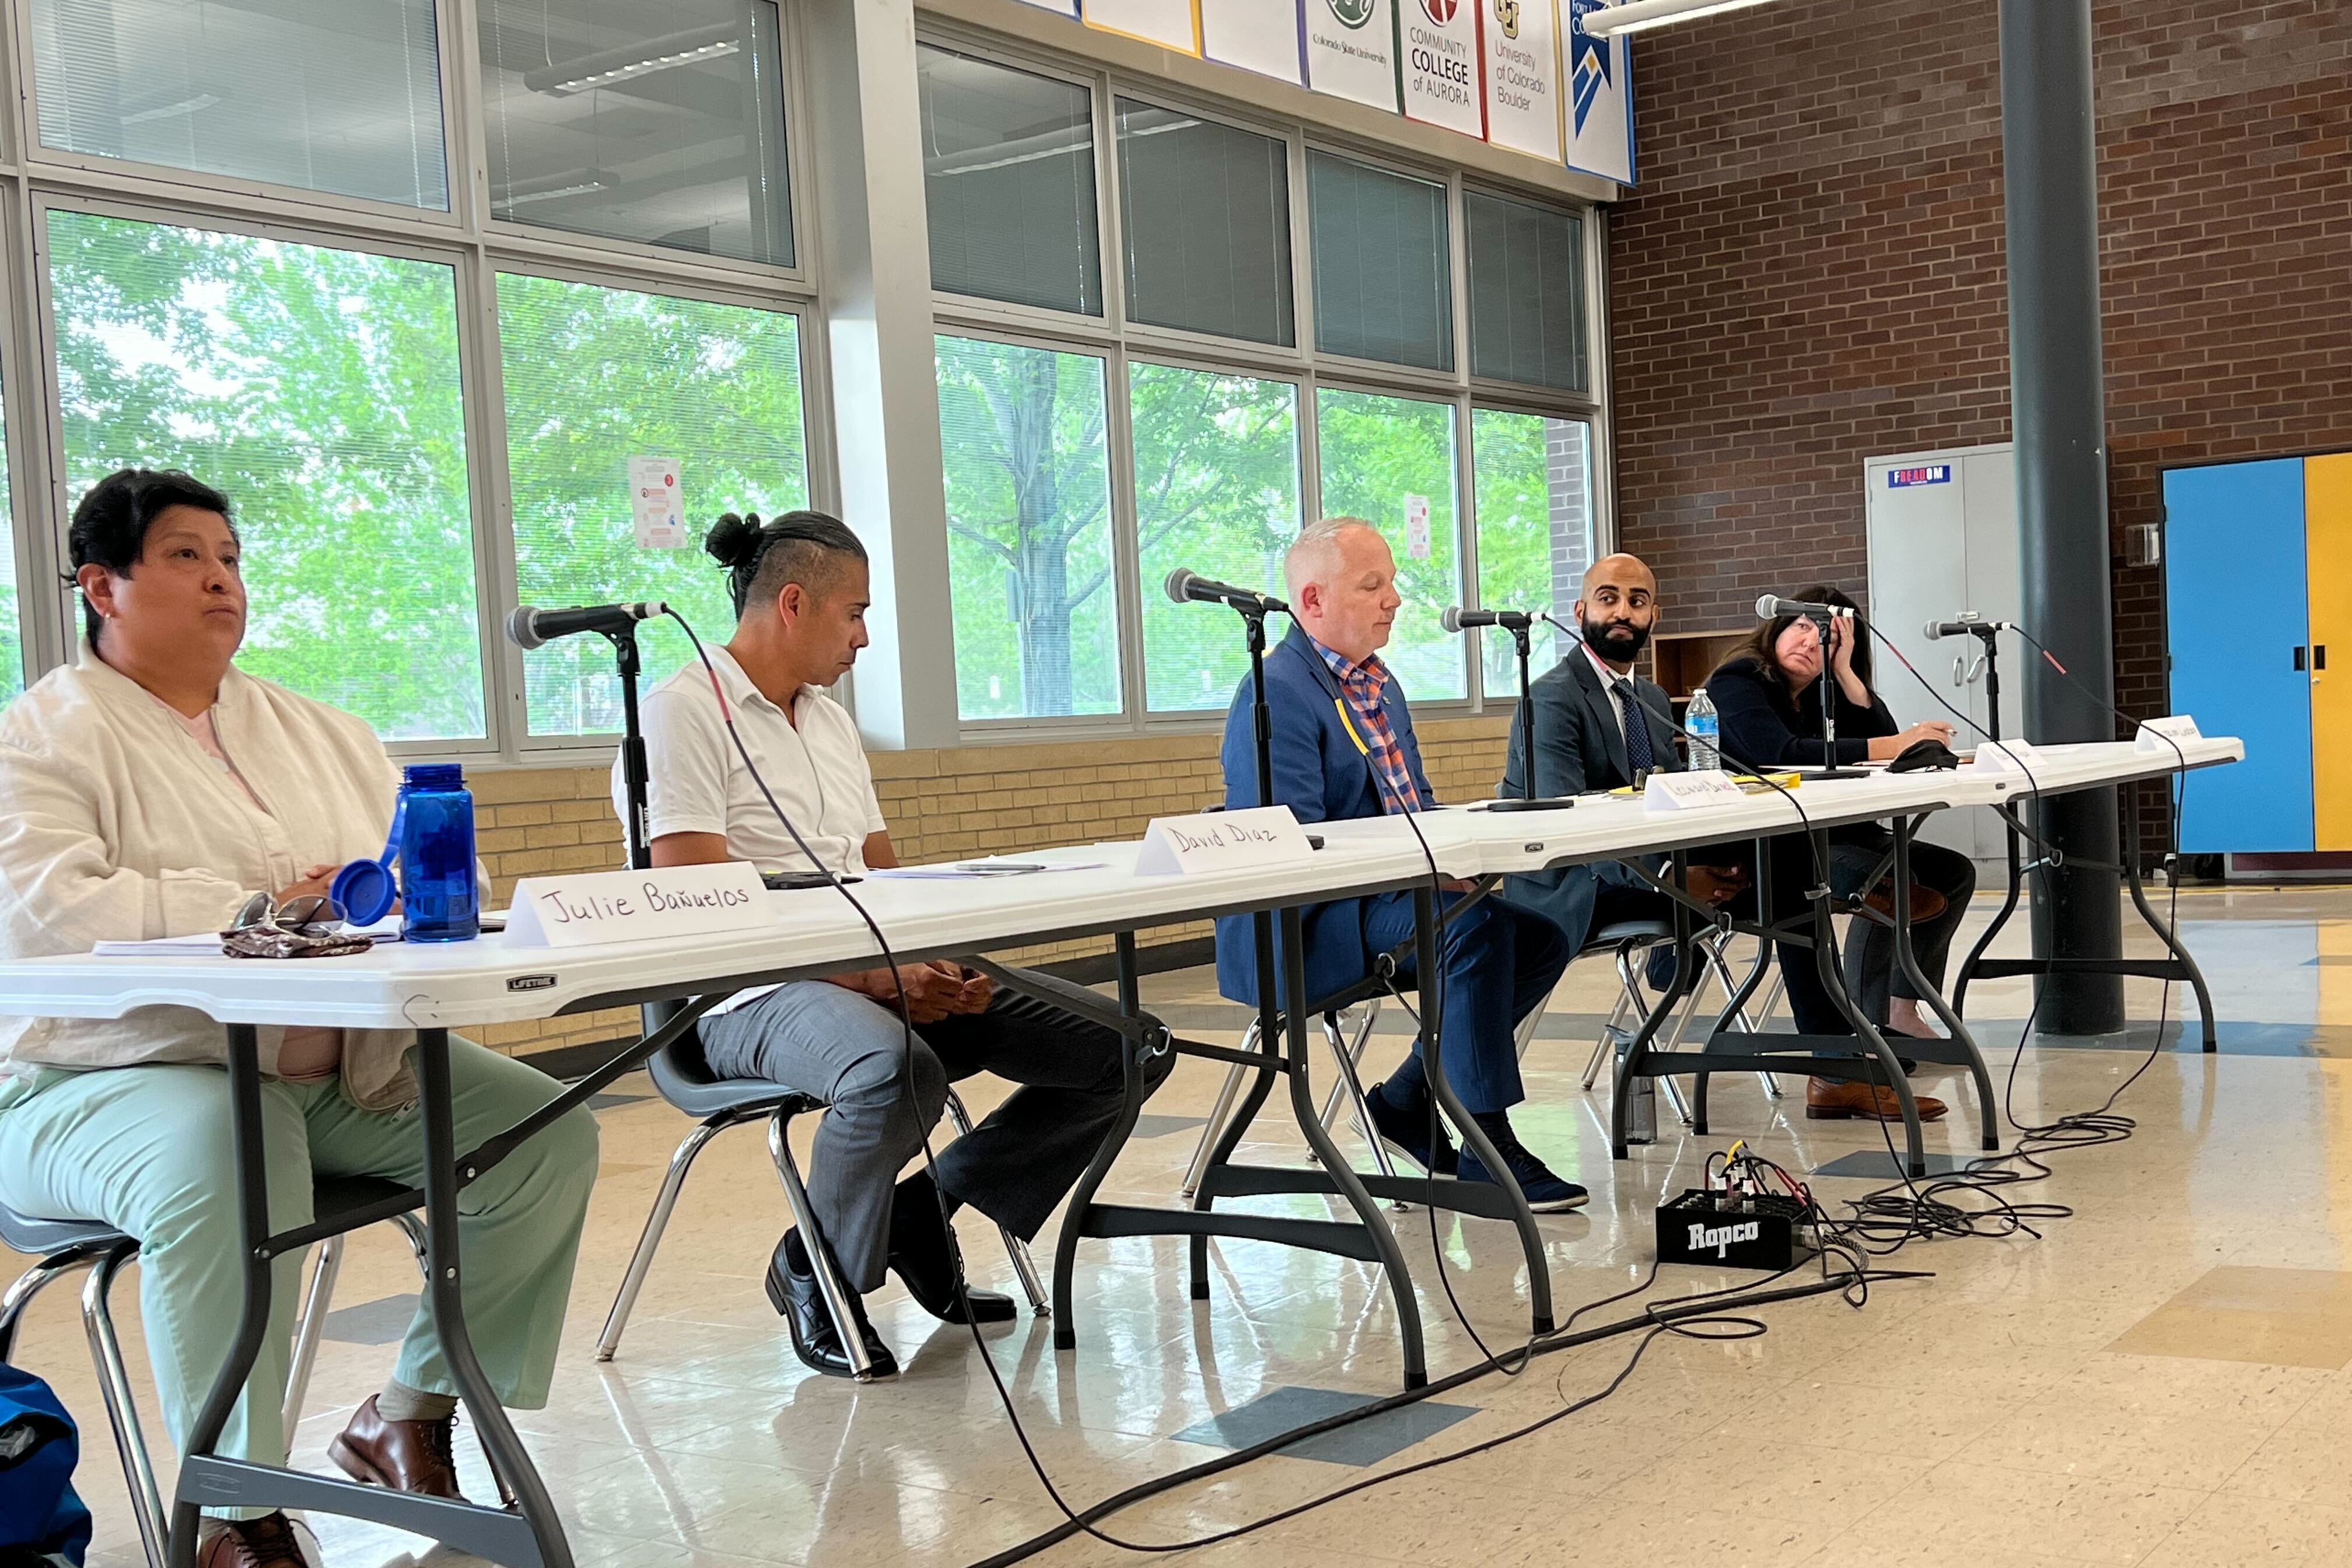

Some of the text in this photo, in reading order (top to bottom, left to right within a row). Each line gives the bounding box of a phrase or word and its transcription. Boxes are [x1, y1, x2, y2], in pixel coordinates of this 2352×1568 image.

[1312, 33, 1387, 69] Colorado State University
[1410, 27, 1466, 58] COMMUNITY
[1495, 40, 1536, 72] University
[1412, 48, 1468, 86] COLLEGE
[1496, 65, 1545, 94] of Colorado
[1413, 76, 1471, 107] of AURORA
[1497, 86, 1531, 111] Boulder
[1894, 467, 1943, 484] FREADOM
[1167, 827, 1226, 853] David
[541, 882, 749, 923] Julie Bañuelos
[1688, 1221, 1759, 1259] Rapco
